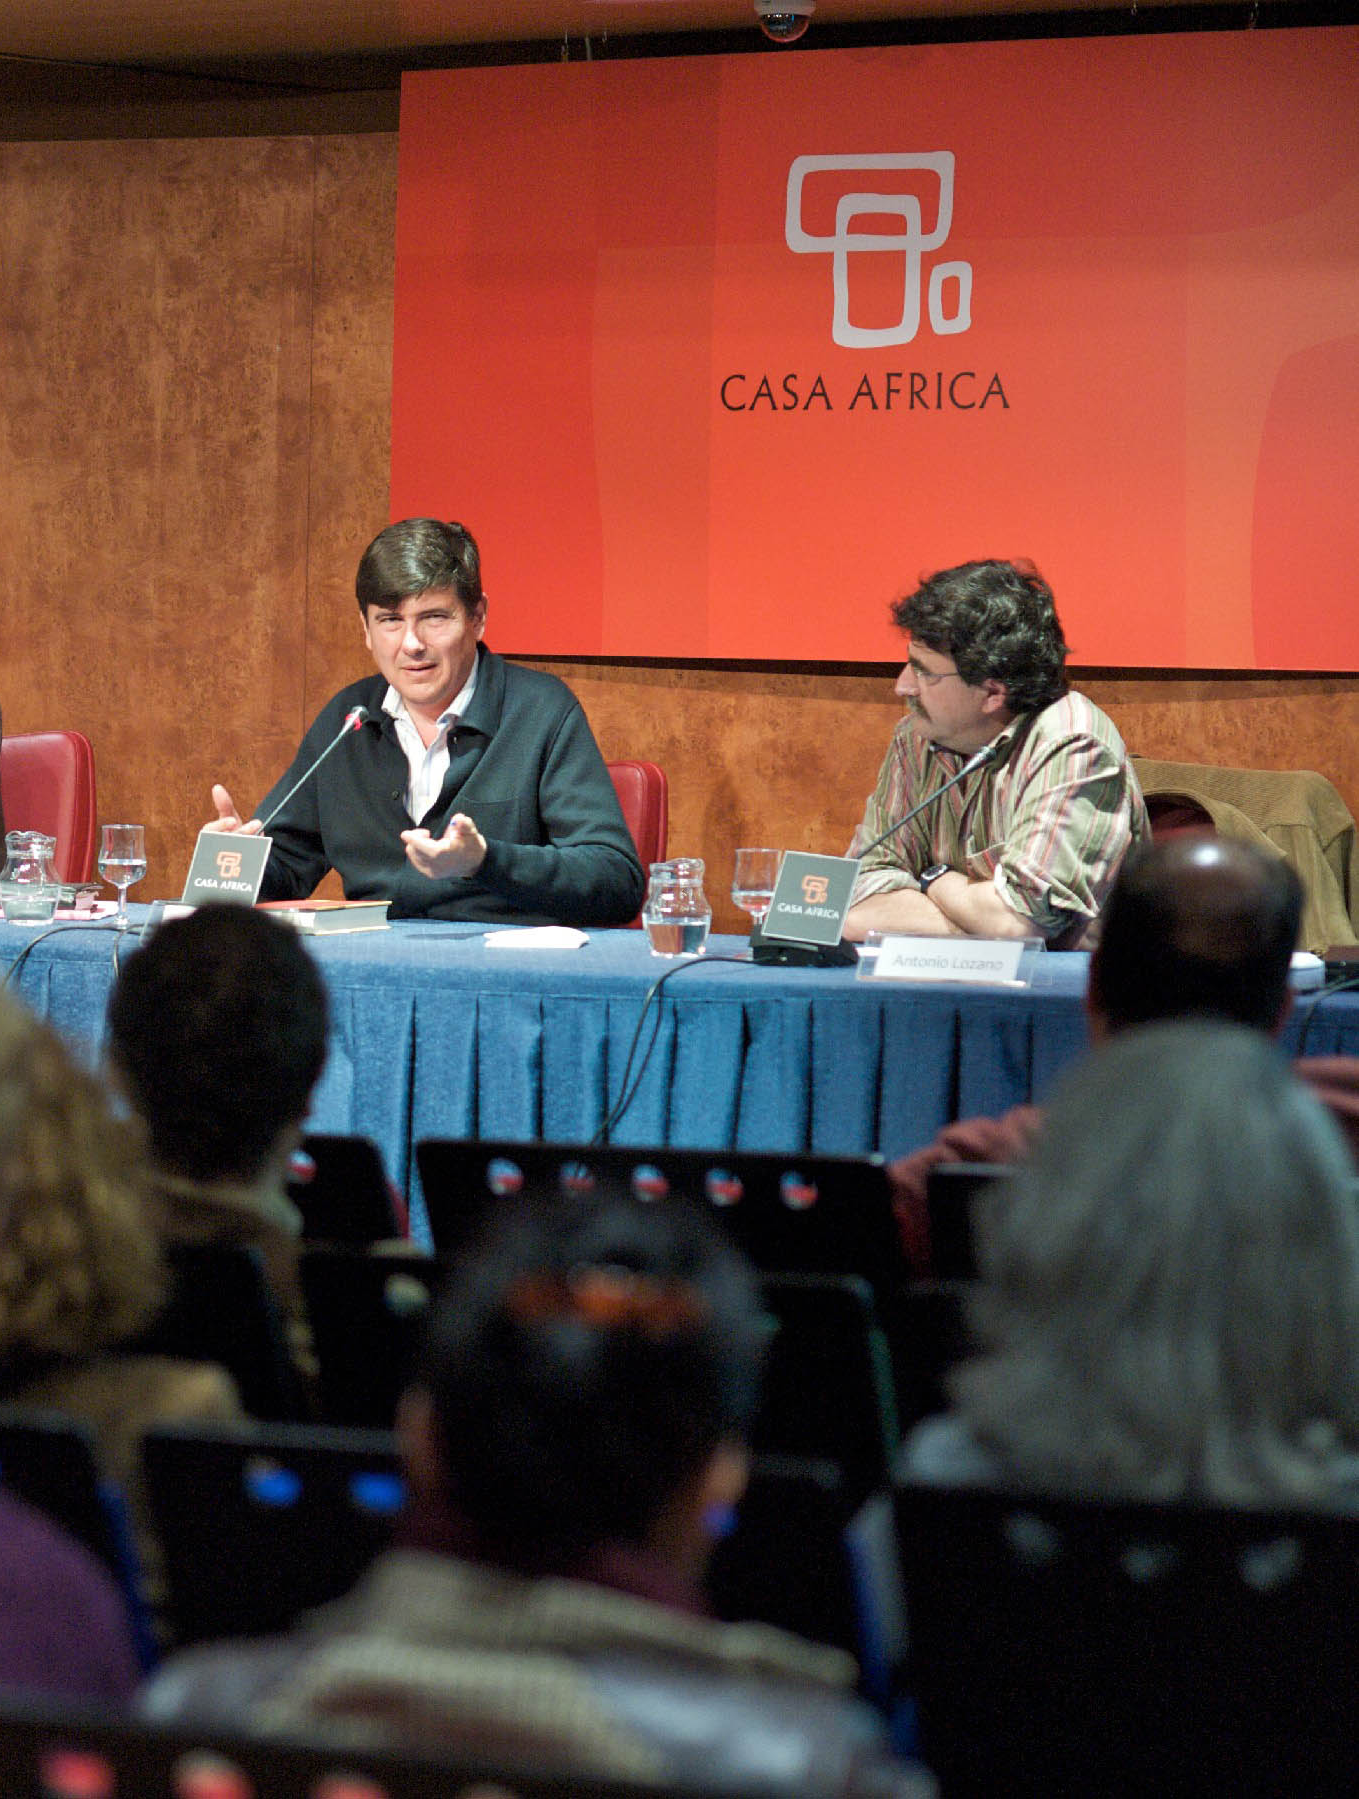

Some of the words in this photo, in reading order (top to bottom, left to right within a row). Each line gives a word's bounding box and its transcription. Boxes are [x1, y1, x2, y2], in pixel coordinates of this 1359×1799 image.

[720, 373, 833, 411] CASA
[848, 371, 1010, 410] AFRICA
[194, 877, 218, 889] CASA
[220, 880, 253, 893] AFRICA
[777, 902, 802, 914] CASA
[804, 906, 840, 920] AFRICA
[892, 954, 949, 969] Antonio
[952, 956, 1005, 971] Lozano
